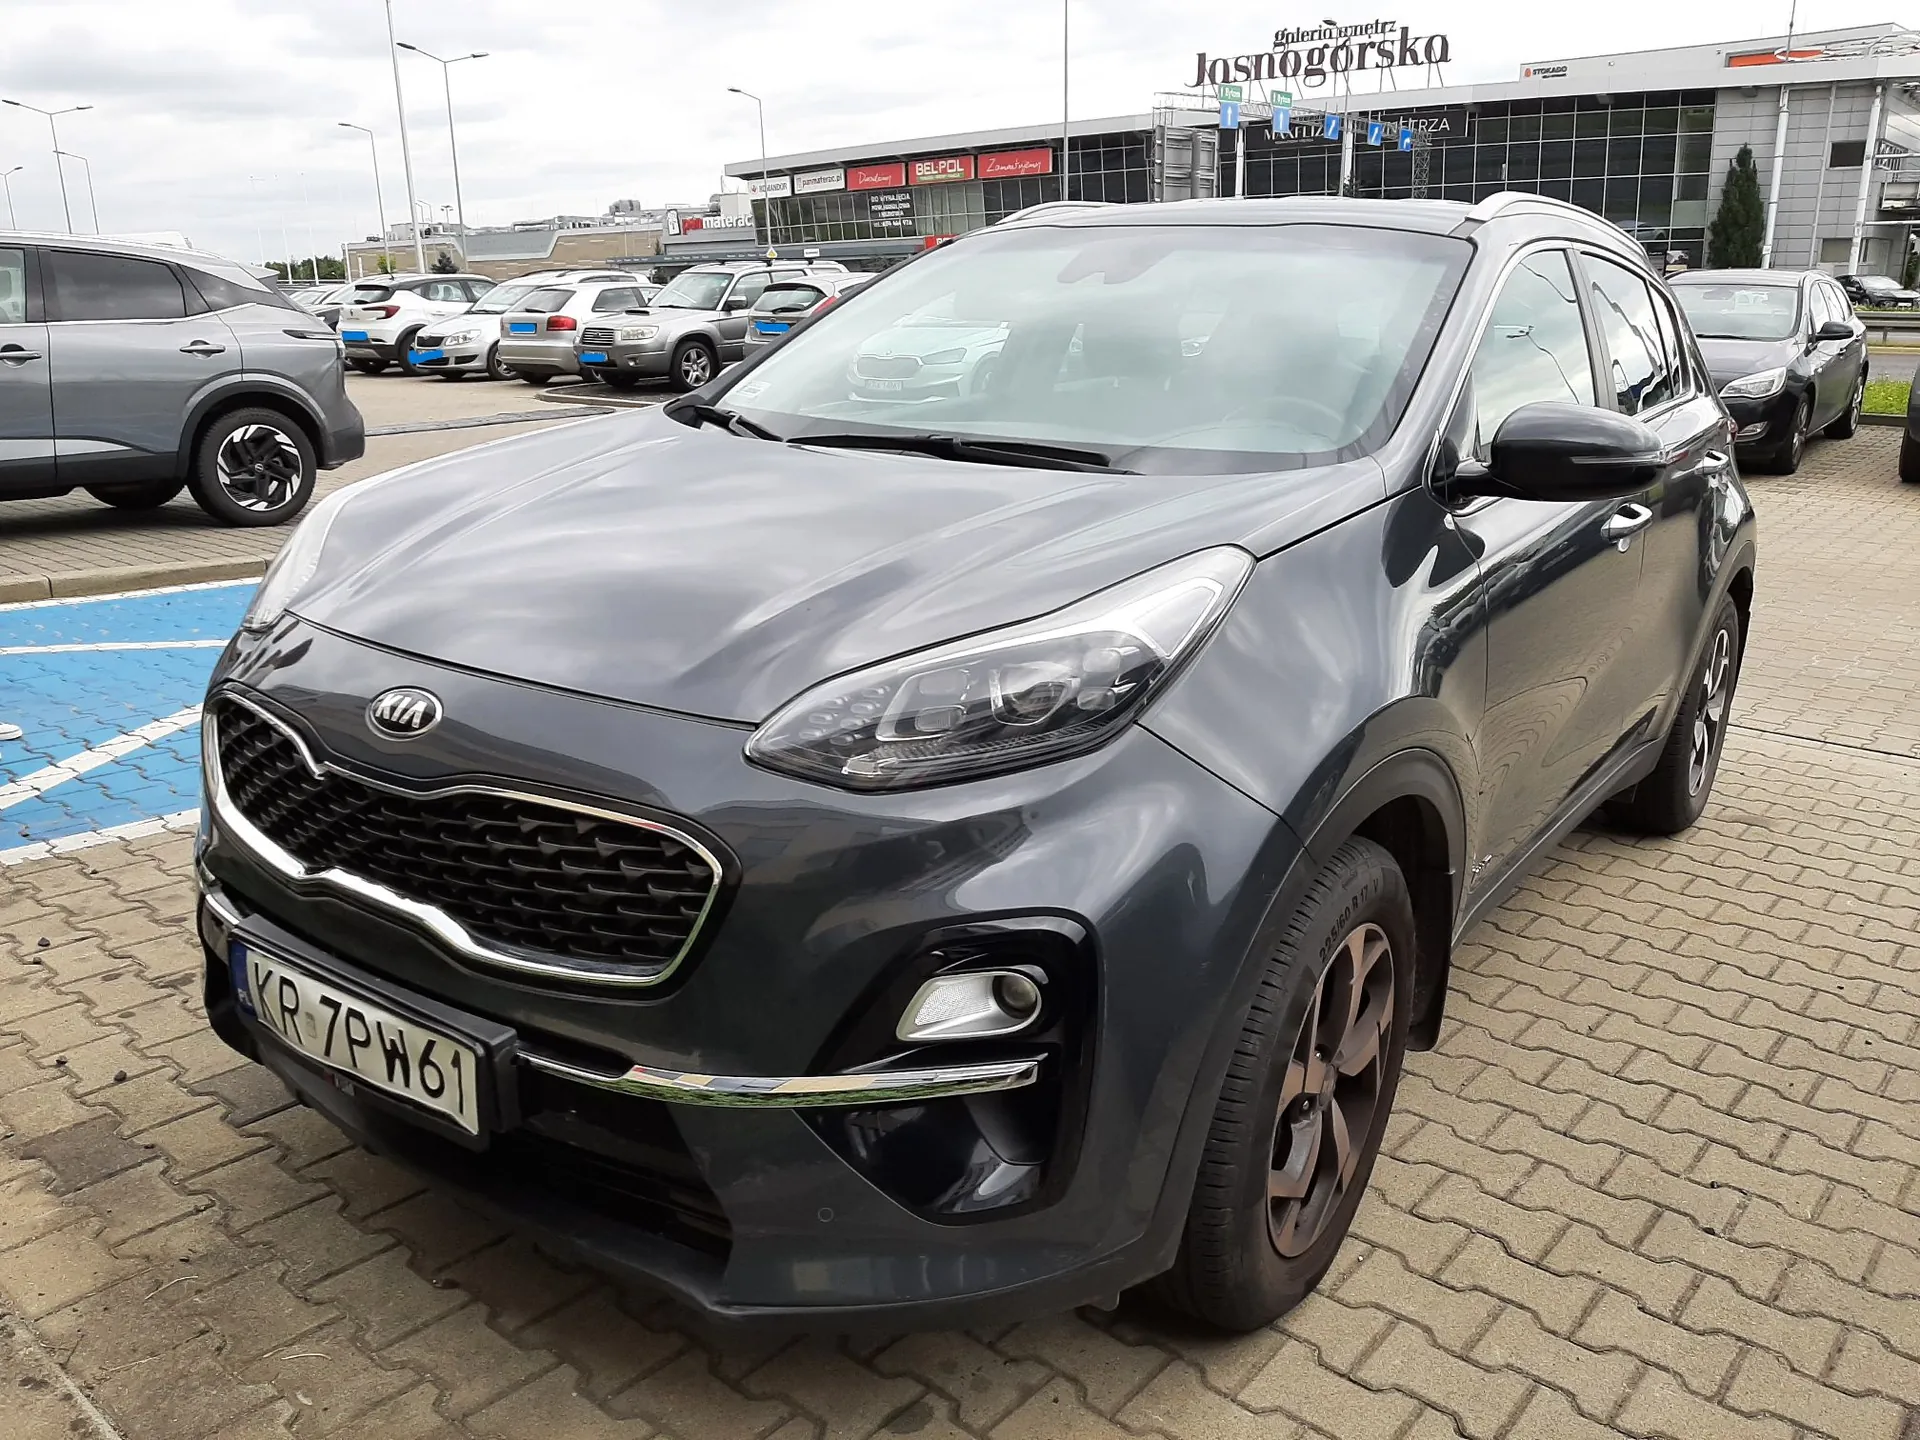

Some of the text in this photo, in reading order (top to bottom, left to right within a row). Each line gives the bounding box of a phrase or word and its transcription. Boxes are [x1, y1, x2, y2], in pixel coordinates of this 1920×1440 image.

[1184, 26, 1452, 88] Jasnogórska
[1273, 19, 1397, 54] galeria wnętrz
[1533, 66, 1567, 75] STOKADO
[375, 693, 427, 729] KIA
[1319, 906, 1351, 963] 225/60
[254, 962, 464, 1115] KR 7PW61
